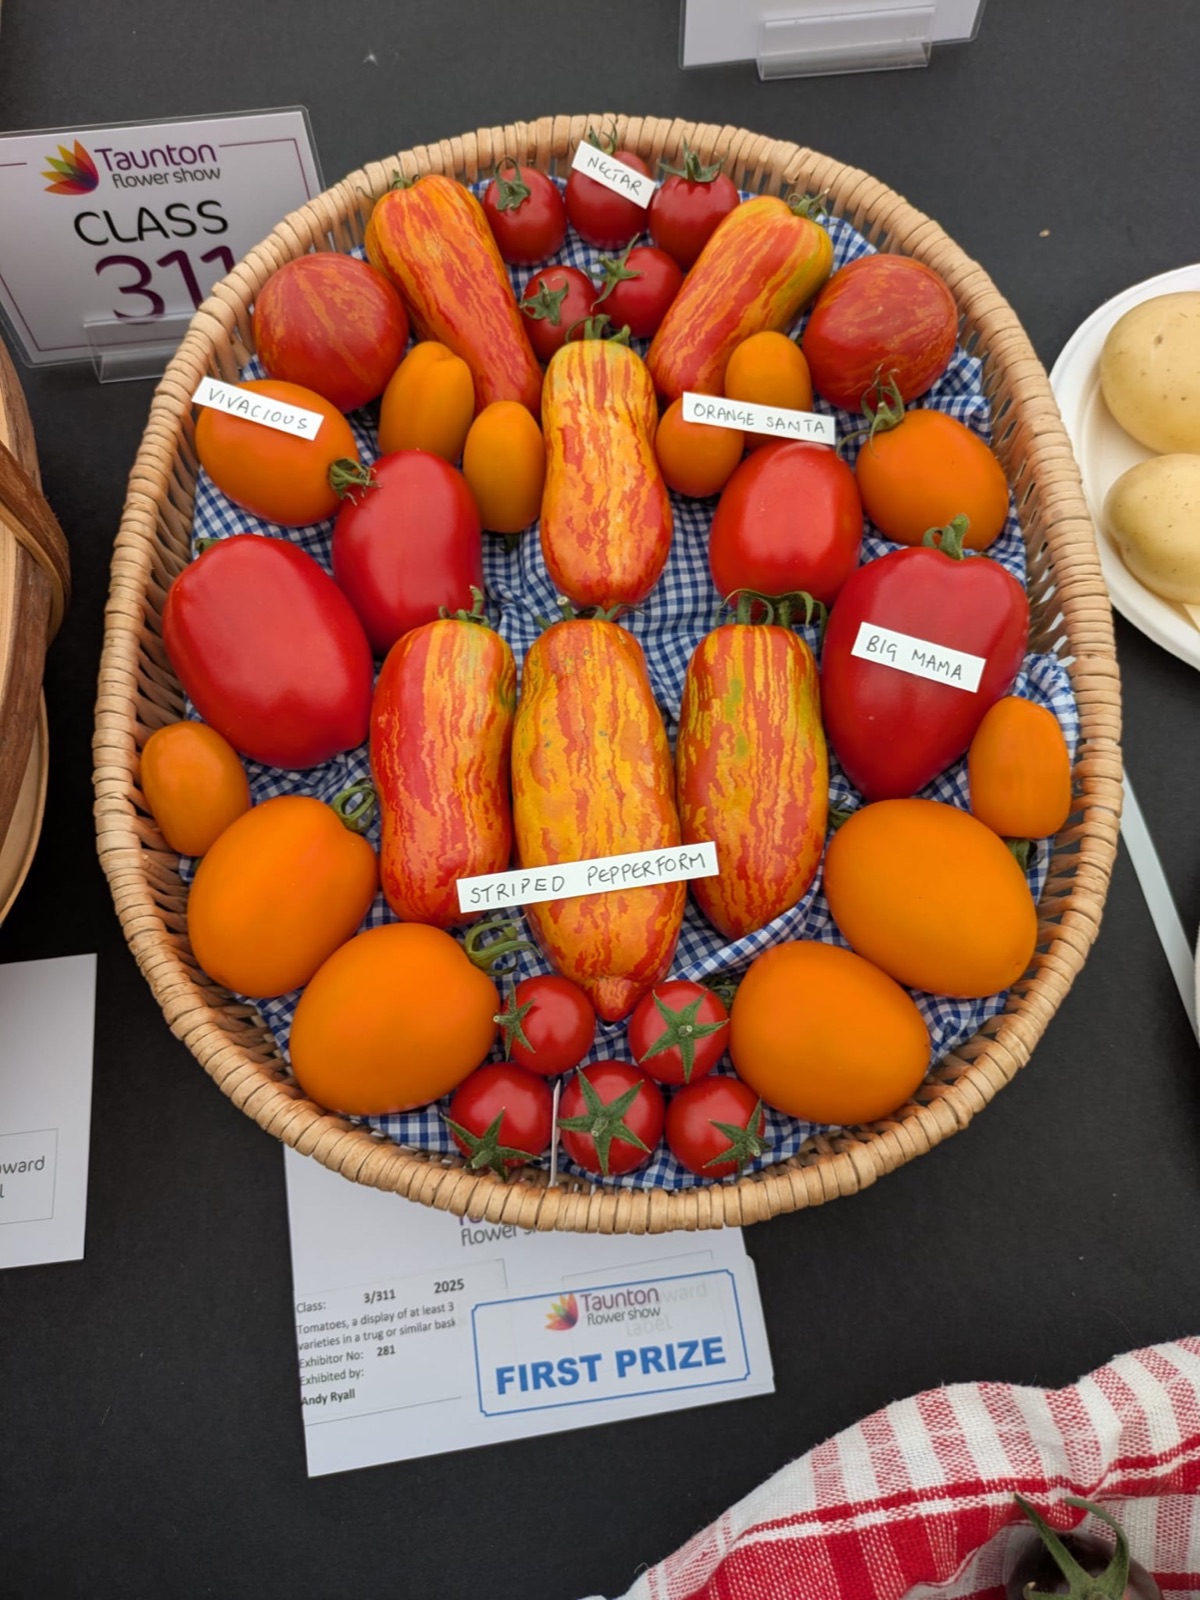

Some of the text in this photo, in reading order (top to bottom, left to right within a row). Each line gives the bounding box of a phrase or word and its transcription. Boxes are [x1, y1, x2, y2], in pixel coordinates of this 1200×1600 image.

[94, 144, 217, 172] Taunton
[111, 166, 221, 189] flower show
[587, 157, 642, 196] NECTAR
[74, 200, 229, 246] CLASS
[208, 388, 308, 430] VIVACIOUS
[693, 403, 825, 434] ORANGE SANTA
[866, 635, 962, 681] BIG MAMA
[470, 852, 706, 904] STRIPED PEPPERFORM
[0, 1155, 45, 1175] ward
[461, 1225, 517, 1247] flower
[296, 1278, 465, 1314] Class: 3/311 2025
[580, 1287, 660, 1313] Taunton
[659, 1280, 708, 1304] ward
[296, 1301, 455, 1335] Tomatoes, a display of at least 3
[586, 1306, 661, 1326] flower show
[298, 1335, 341, 1351] varieties
[342, 1333, 352, 1344] in
[354, 1333, 361, 1343] a
[363, 1330, 384, 1341] trug
[386, 1327, 397, 1338] or
[399, 1321, 432, 1336] similar
[299, 1344, 396, 1369] Exhibitor No: 281
[495, 1336, 727, 1395] FIRST PRIZE
[300, 1367, 364, 1386] Exhibited by:
[301, 1387, 356, 1406] Andy Ryall
